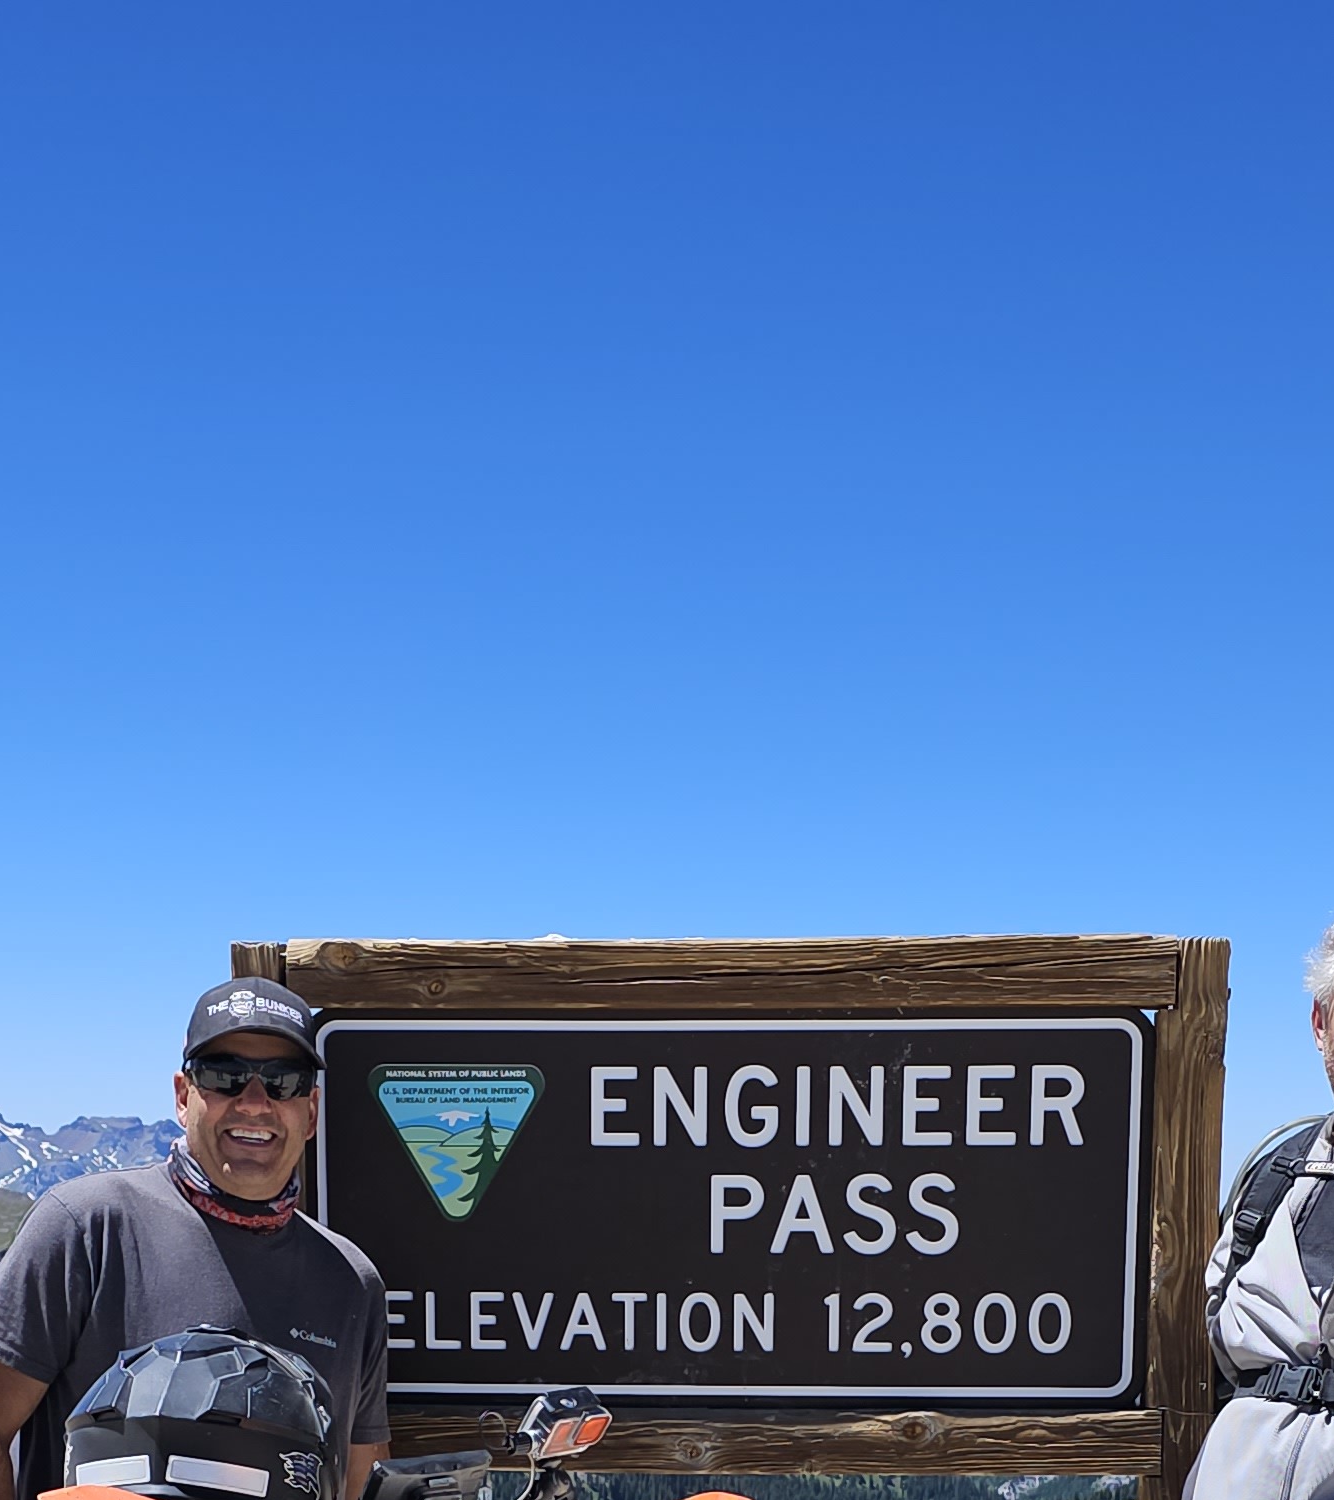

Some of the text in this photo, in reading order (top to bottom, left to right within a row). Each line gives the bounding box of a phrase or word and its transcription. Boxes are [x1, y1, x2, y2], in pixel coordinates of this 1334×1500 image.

[207, 1000, 229, 1016] THE
[256, 997, 303, 1022] BUNKER
[428, 1070, 457, 1078] SYSTEM
[590, 1064, 1085, 1147] ENGINEER
[710, 1173, 960, 1254] PASS
[299, 1329, 336, 1348] Columbia
[387, 1291, 1072, 1358] ELEVATION 12,800
